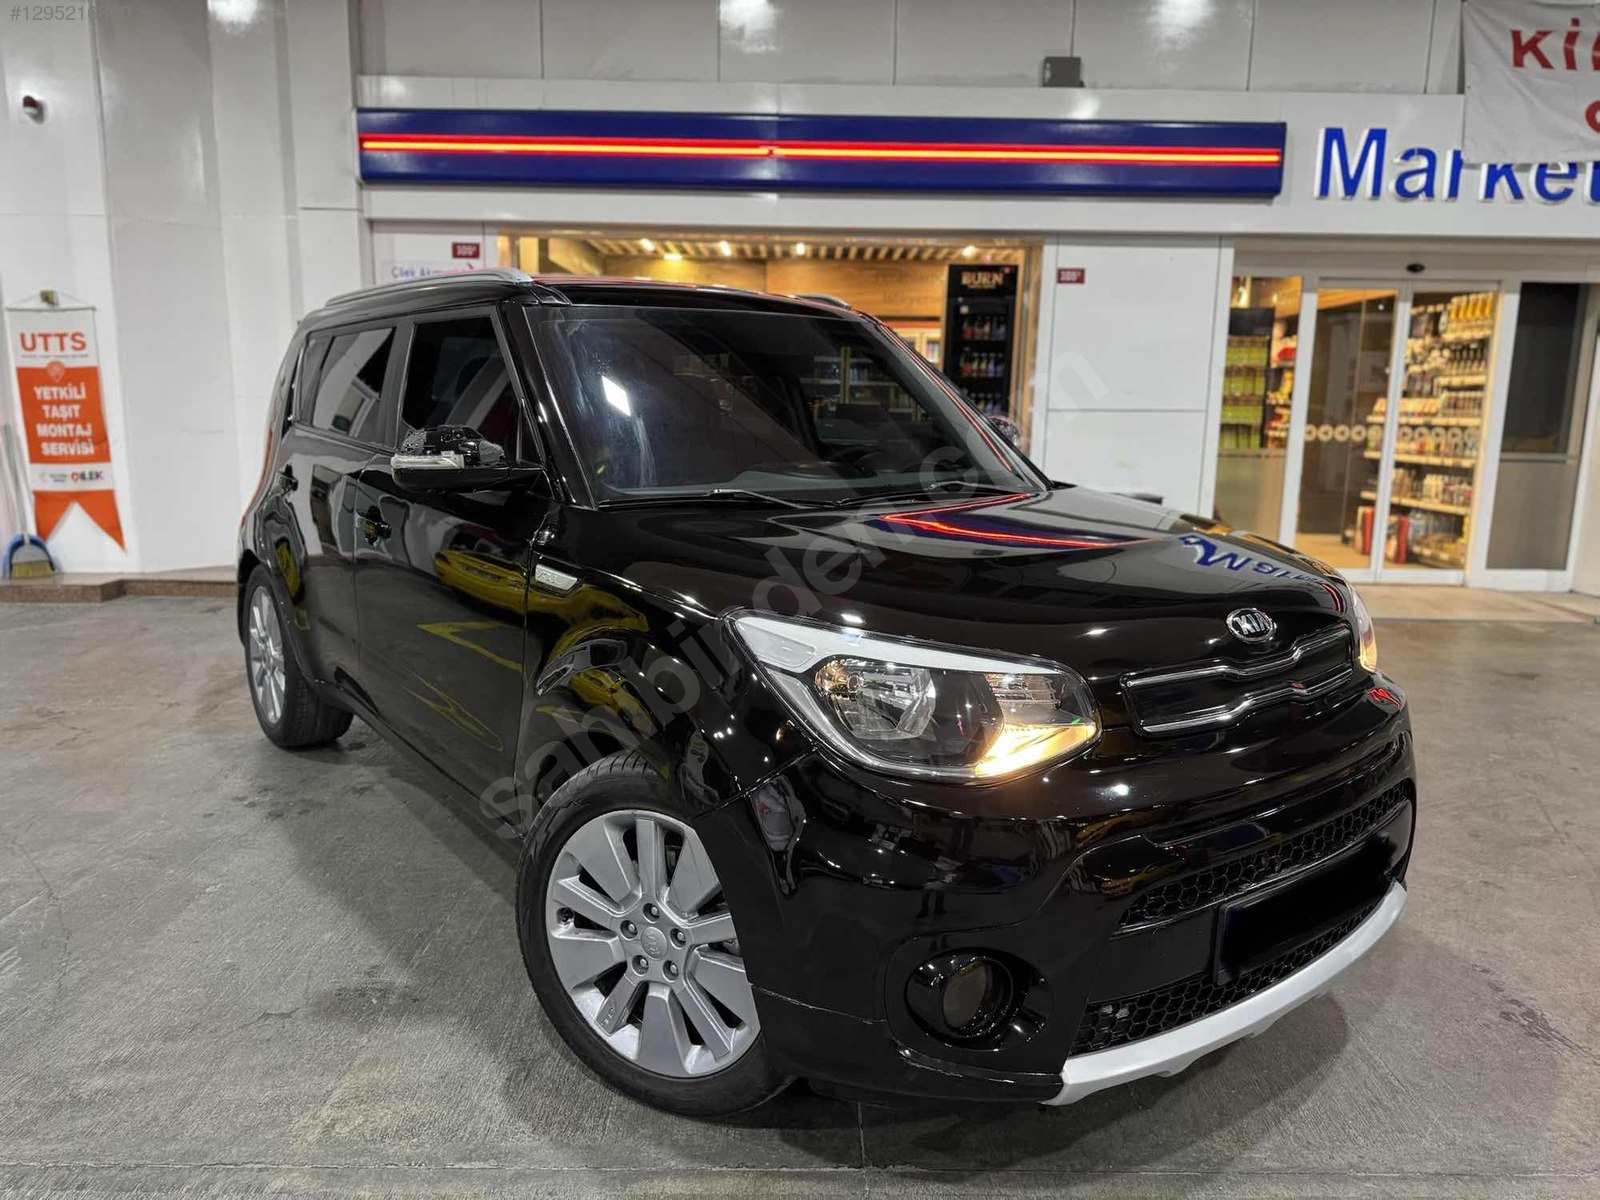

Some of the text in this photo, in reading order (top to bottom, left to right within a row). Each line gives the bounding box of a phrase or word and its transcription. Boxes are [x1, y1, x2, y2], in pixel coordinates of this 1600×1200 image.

[961, 271, 1004, 284] BURN
[19, 331, 87, 352] UTTS
[33, 382, 86, 400] YETKİLİ
[42, 404, 80, 421] TAŞIT
[36, 422, 92, 438] MONTAJ
[41, 438, 95, 456] SERVİSİ
[1233, 612, 1270, 635] KIA
